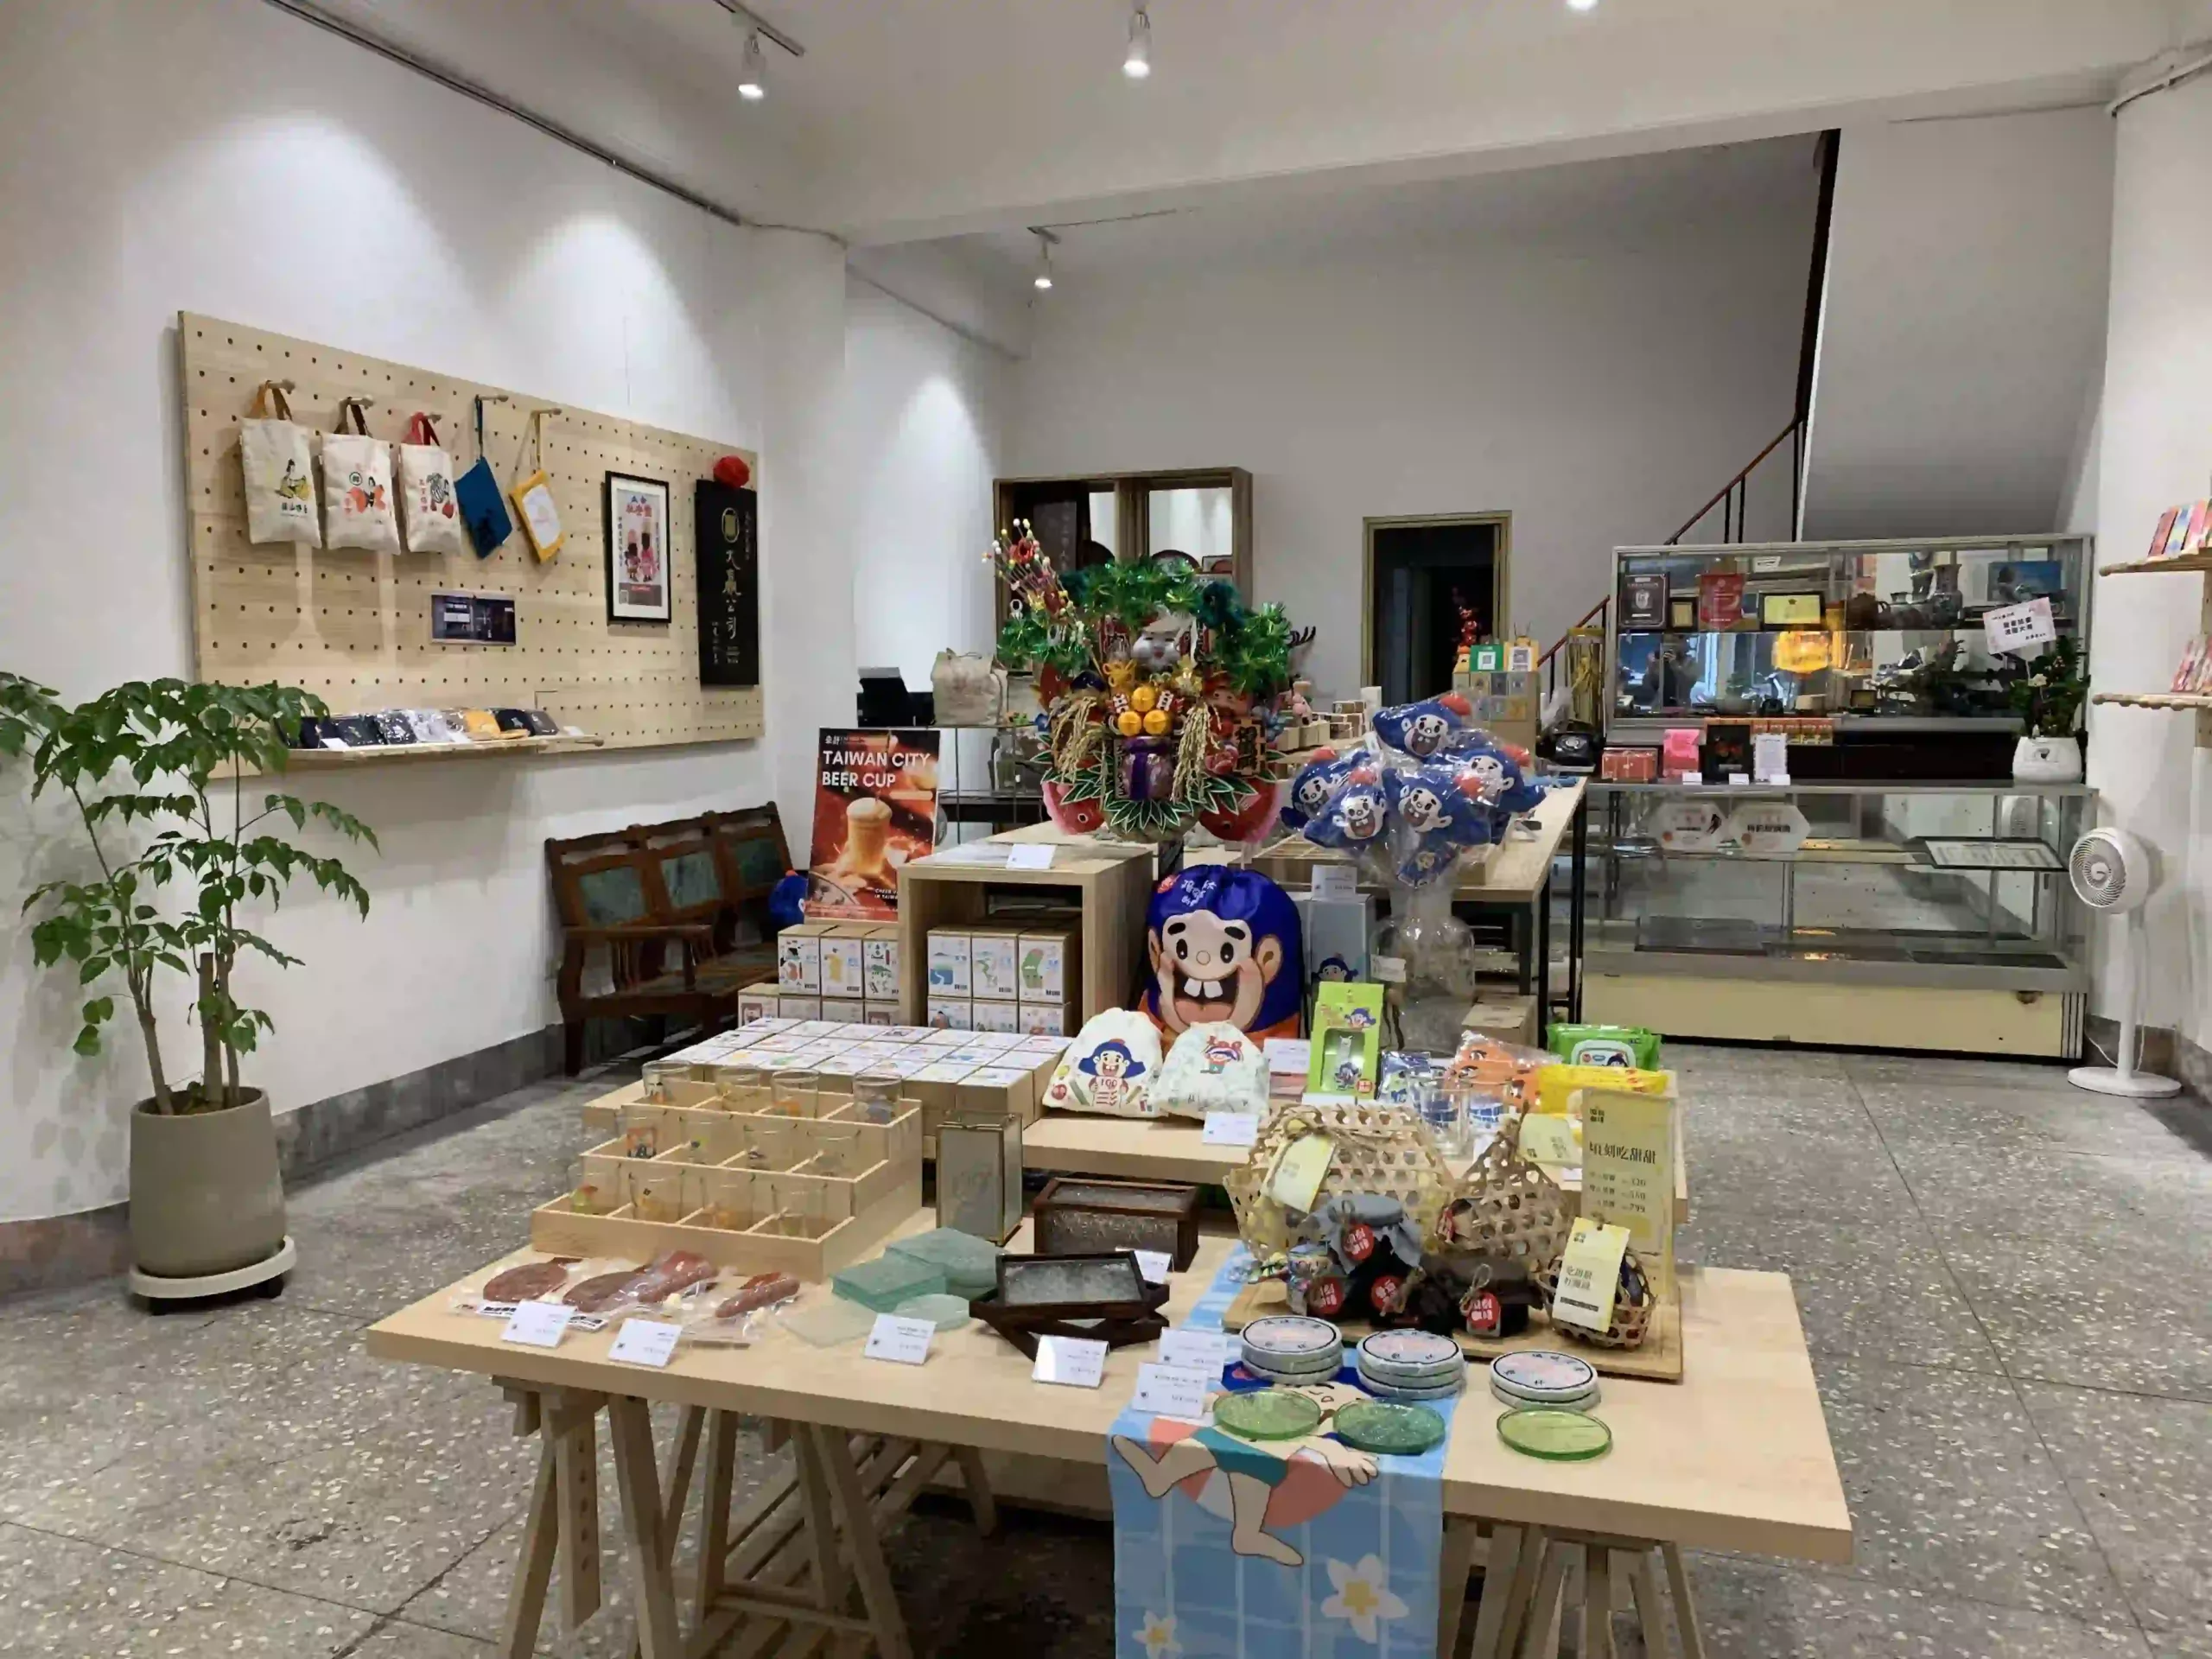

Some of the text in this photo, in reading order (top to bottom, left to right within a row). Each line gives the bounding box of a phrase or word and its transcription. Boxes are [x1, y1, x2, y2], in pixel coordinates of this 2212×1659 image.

[823, 750, 931, 767] TAIWAN CITY
[822, 771, 896, 787] BEER CUP
